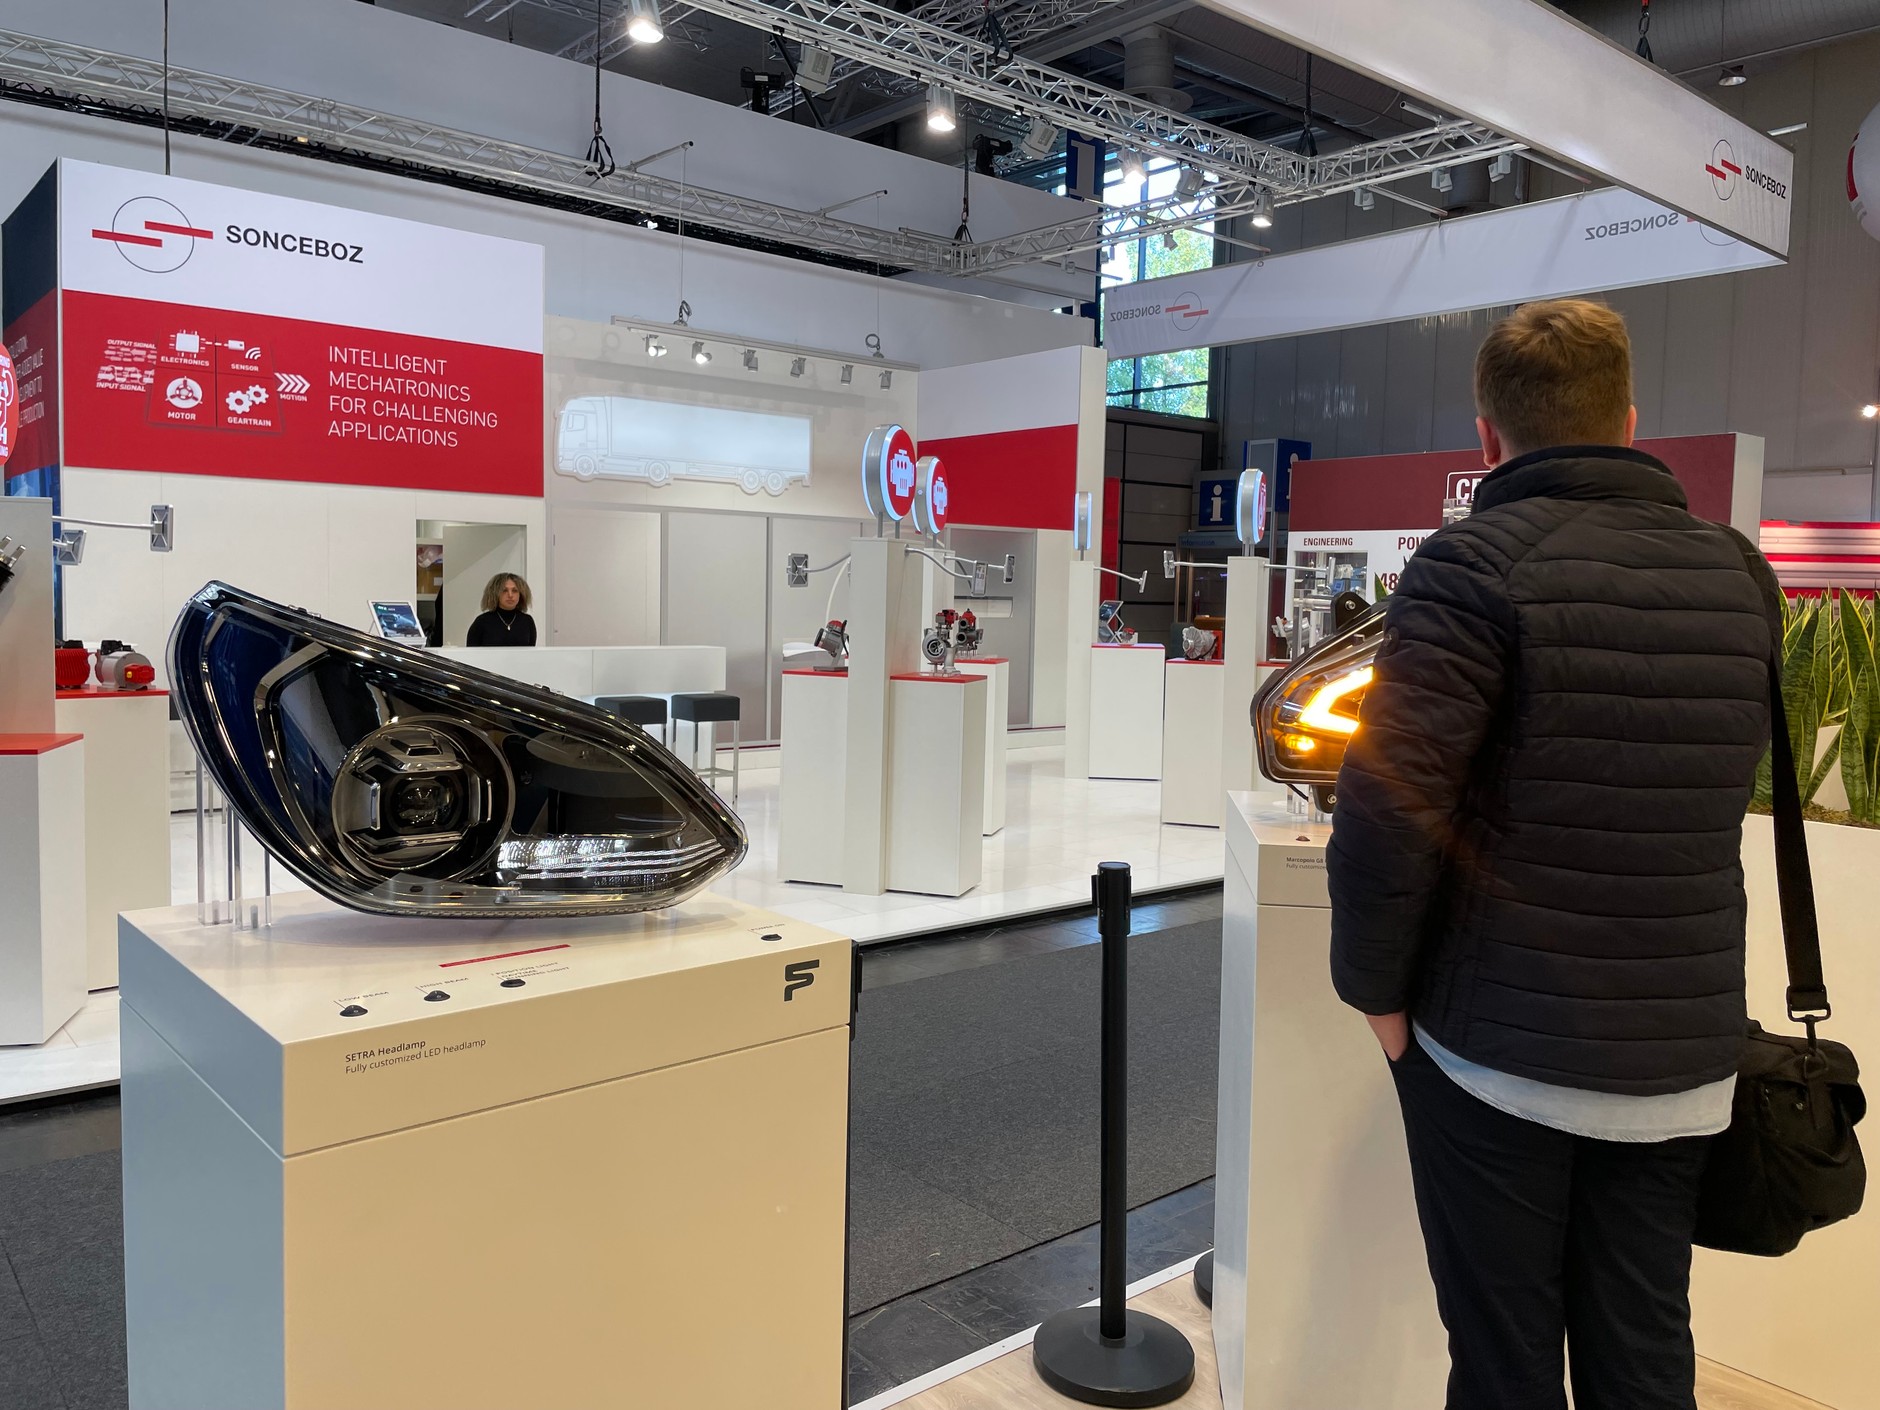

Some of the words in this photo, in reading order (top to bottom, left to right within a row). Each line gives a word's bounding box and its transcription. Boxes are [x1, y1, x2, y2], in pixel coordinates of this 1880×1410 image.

[1745, 165, 1787, 200] SONCEBOZ
[226, 224, 364, 264] SONCEBOZ
[107, 339, 133, 347] OUTPUT
[133, 341, 156, 349] SIGNAL
[161, 355, 209, 367] ELECTRONICS
[231, 363, 259, 372] SENSOR
[329, 345, 447, 375] INTELLIGENT
[96, 381, 119, 389] INPUT
[119, 383, 146, 392] SIGNAL
[329, 370, 471, 402] MECHATRONICS
[280, 393, 307, 402] MOTION
[168, 411, 196, 420] MOTOR
[329, 395, 366, 415] FOR
[373, 400, 498, 428] CHALLENGING
[227, 416, 272, 427] GEARTRAIN
[328, 420, 458, 447] APPLICATIONS
[1303, 537, 1353, 547] ENGINEERING
[345, 1049, 376, 1063] SETRA
[378, 1040, 426, 1056] Headlamp
[345, 1063, 367, 1074] Fully
[369, 1052, 422, 1069] customized
[424, 1047, 441, 1058] LED
[443, 1039, 486, 1054] headlamp
